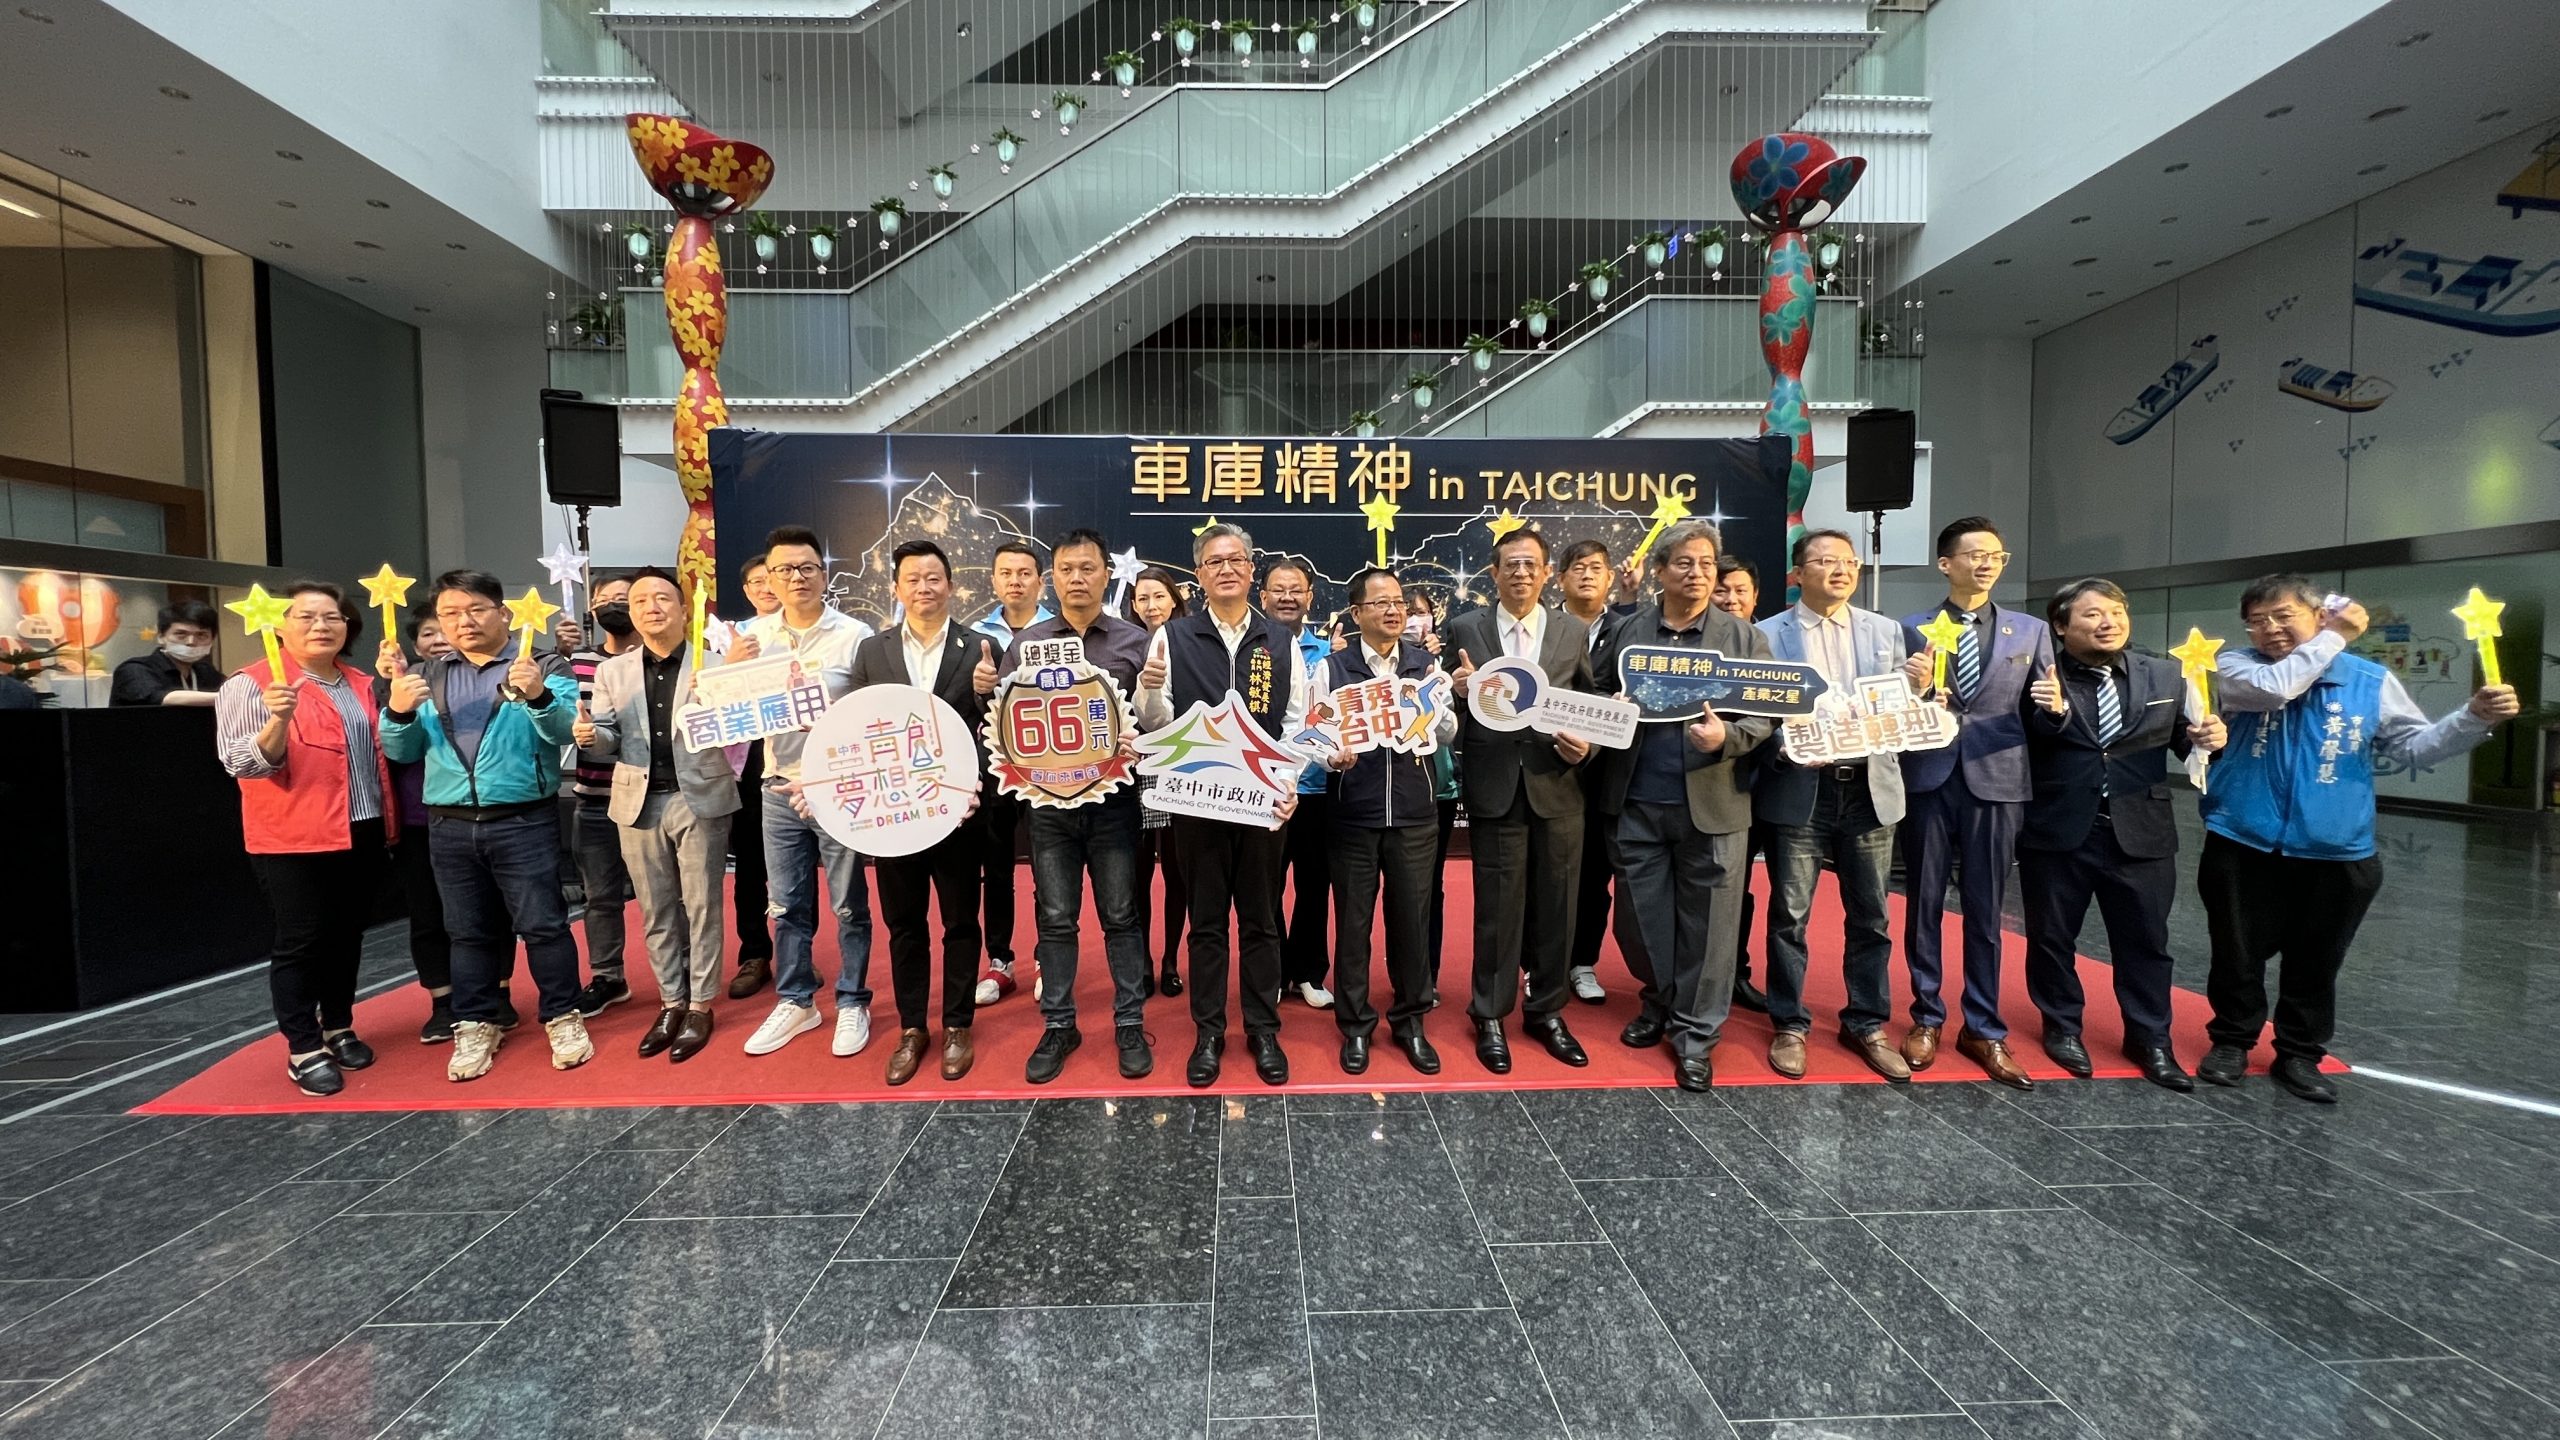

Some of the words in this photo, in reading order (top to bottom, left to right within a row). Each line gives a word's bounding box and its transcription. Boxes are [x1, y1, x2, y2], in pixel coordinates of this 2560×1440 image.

[1130, 442, 1412, 504] 車庫精神
[1429, 468, 1464, 500] in
[1479, 471, 1697, 502] TAICHUNG
[1025, 641, 1081, 667] 總獎金
[1628, 654, 1713, 677] 車庫精神
[1716, 667, 1728, 677] in
[1733, 668, 1802, 682] TAICHUNG
[1040, 670, 1070, 689] 高達
[1742, 687, 1801, 704] 產業之星
[1336, 680, 1395, 715] 青秀
[1542, 697, 1629, 725] 臺中市政府經濟發展局
[685, 684, 827, 748] 商業應用
[1012, 695, 1085, 756] 66
[1087, 698, 1110, 749] 萬元
[1339, 709, 1402, 747] 台中
[1787, 706, 1944, 758] 製造轉型
[832, 765, 946, 819] 夢想家
[1152, 794, 1195, 807] TAICHUNG
[1197, 801, 1217, 810] CITY
[1165, 777, 1266, 807] 臺中市政府
[877, 809, 920, 827] DREAM
[927, 803, 949, 818] BIG
